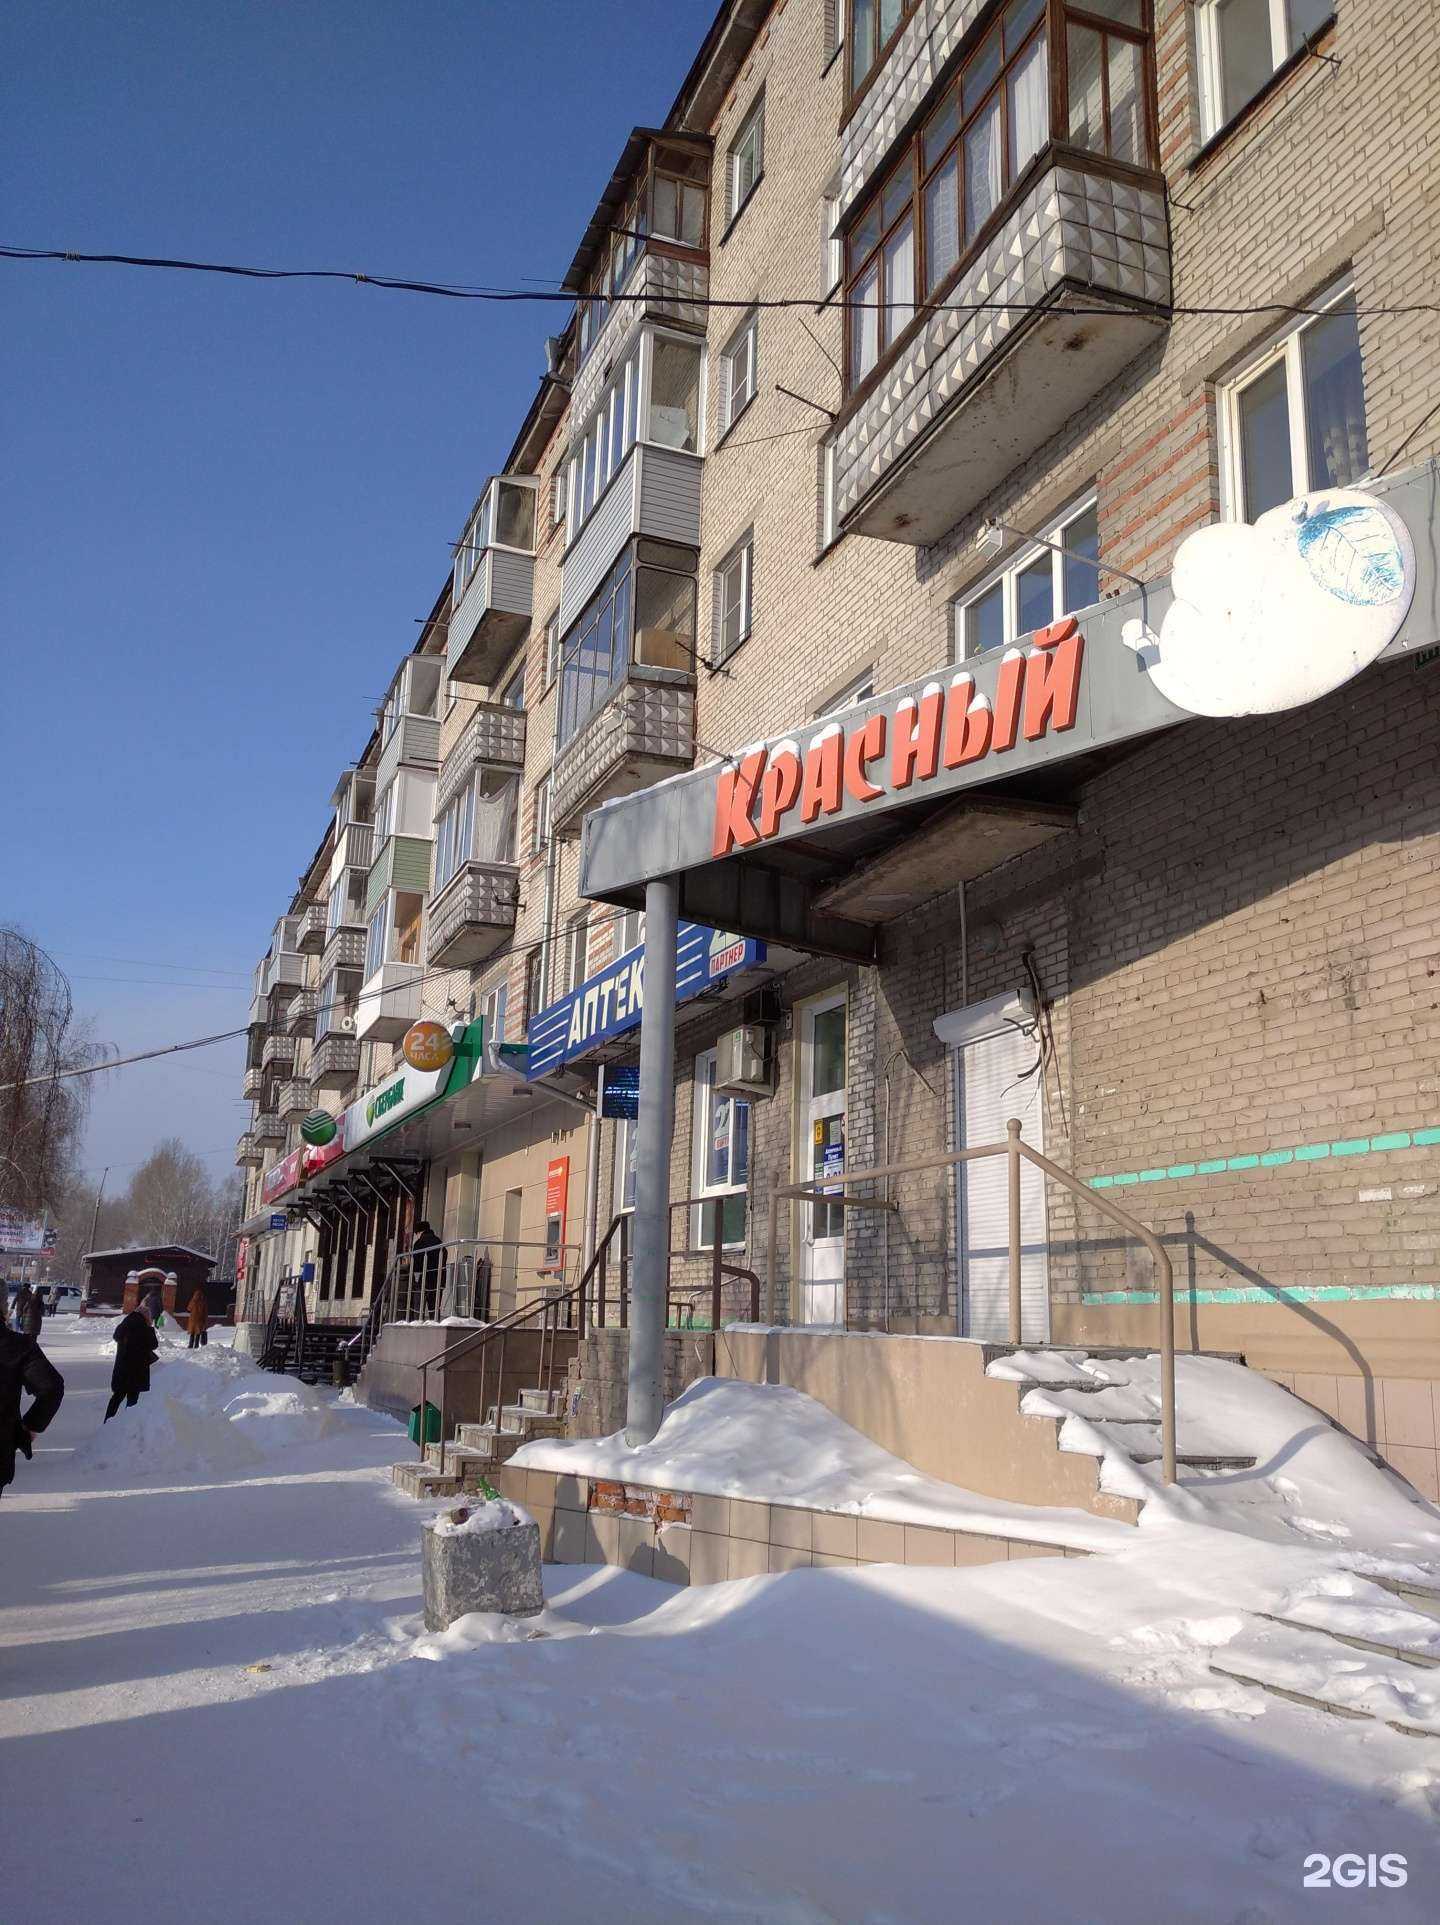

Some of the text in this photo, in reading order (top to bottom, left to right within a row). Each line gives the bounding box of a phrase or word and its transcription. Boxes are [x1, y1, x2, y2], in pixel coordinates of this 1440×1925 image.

[713, 616, 1083, 857] КРАСНЫЙ
[711, 943, 744, 976] ПАРТНЕР
[567, 955, 644, 1050] АПТЕК
[411, 1032, 438, 1051] 24
